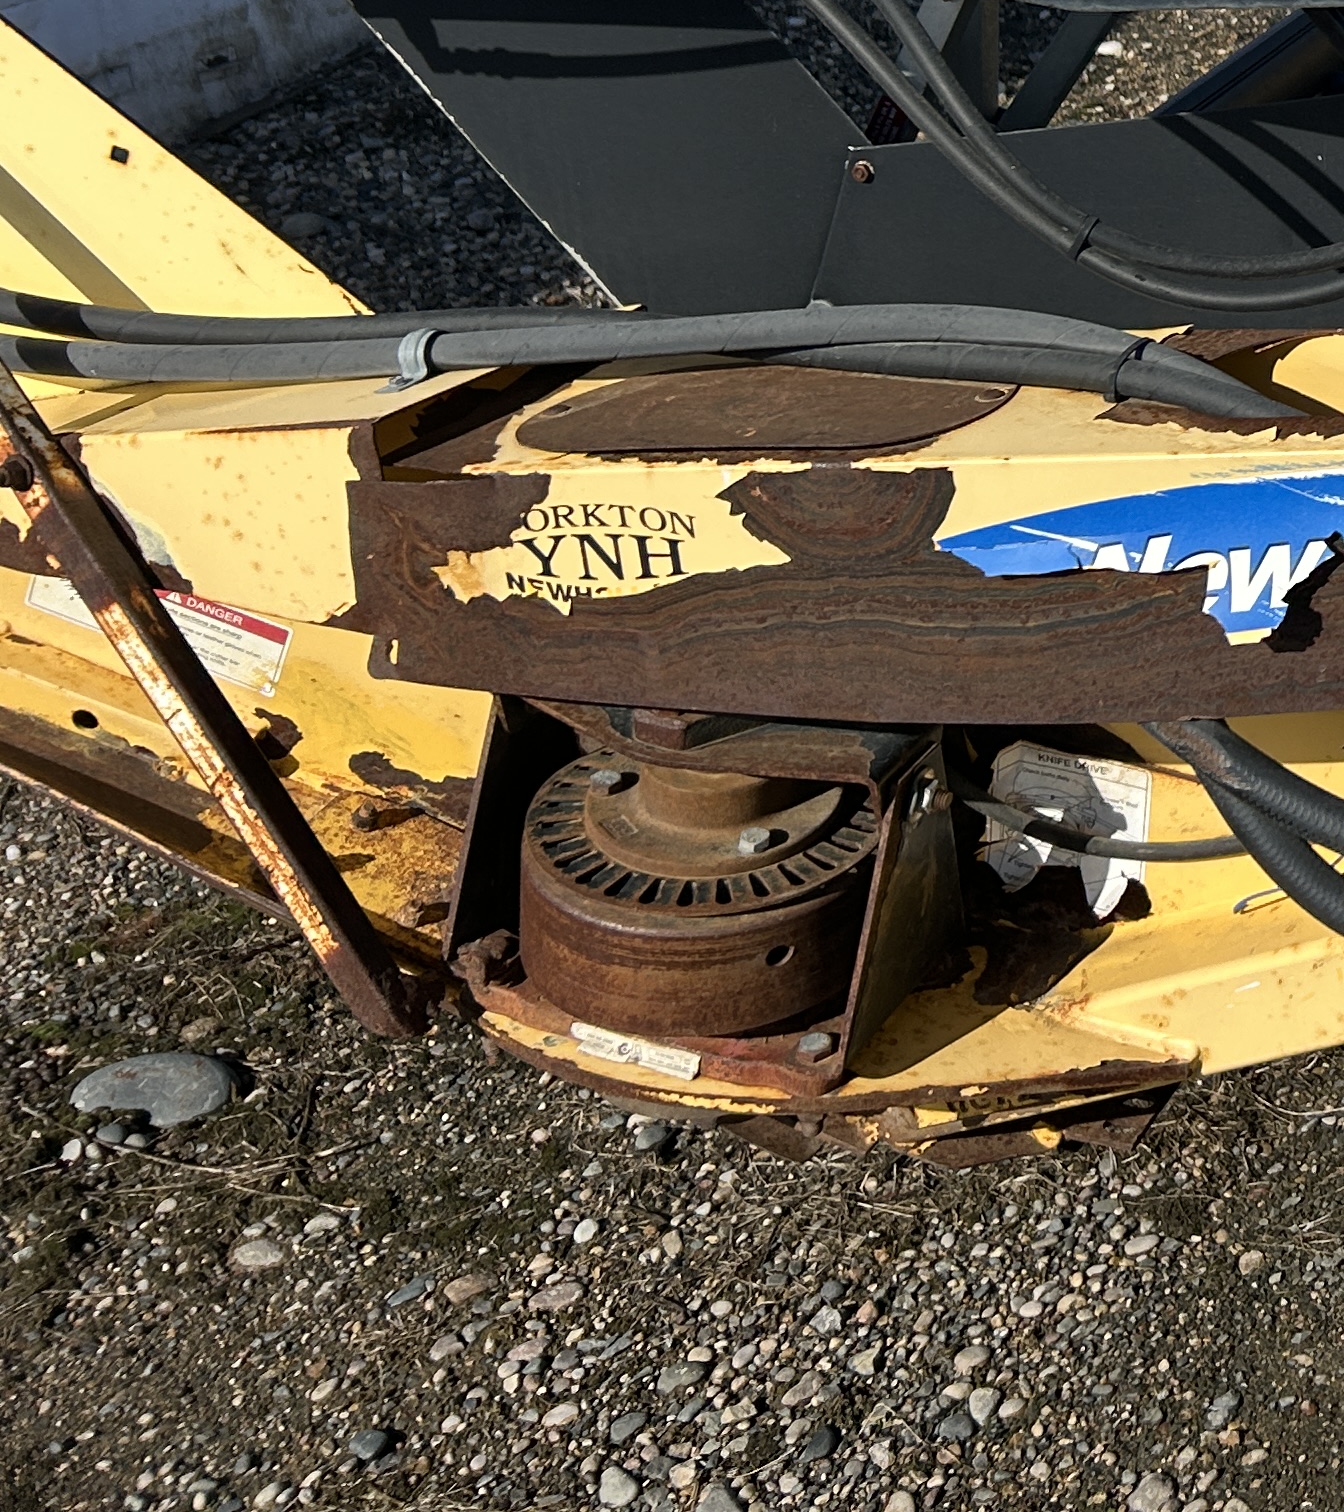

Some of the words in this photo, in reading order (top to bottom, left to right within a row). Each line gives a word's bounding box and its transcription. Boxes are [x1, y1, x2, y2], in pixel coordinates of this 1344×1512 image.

[516, 534, 688, 580] YNH
[186, 596, 244, 625] DANGER
[1037, 753, 1072, 768] KNIFE
[1073, 759, 1108, 776] DRIVE
